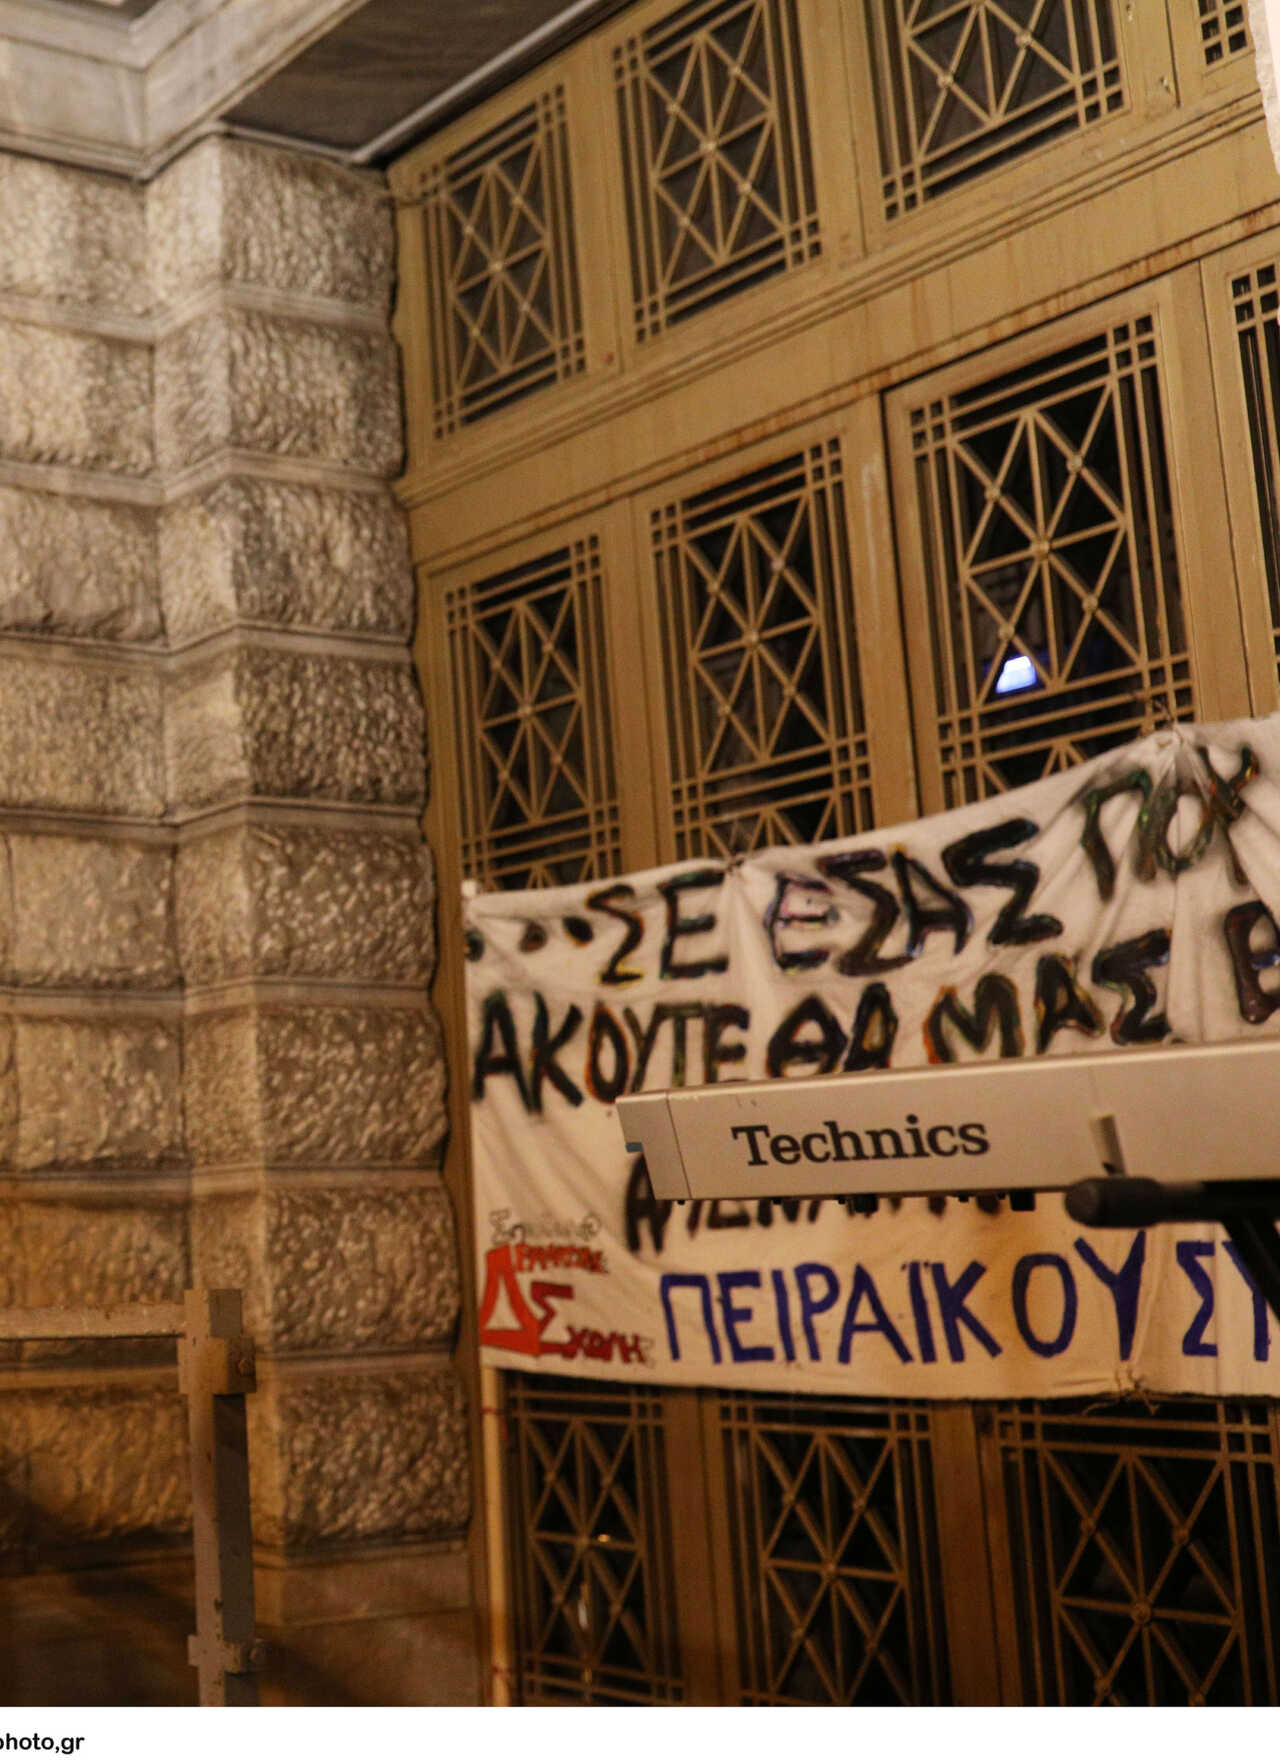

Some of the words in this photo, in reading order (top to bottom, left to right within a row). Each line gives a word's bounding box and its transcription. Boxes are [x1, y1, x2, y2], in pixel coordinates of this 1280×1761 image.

[1075, 742, 1260, 902] ΠΟΥ
[472, 989, 750, 1116] ΑΚΟΥΤΕ
[923, 928, 1174, 1065] ΜΑΣ
[730, 1114, 990, 1166] Technics
[660, 1229, 1147, 1364] ΠΕΙΡΑΪΚΟΥ
